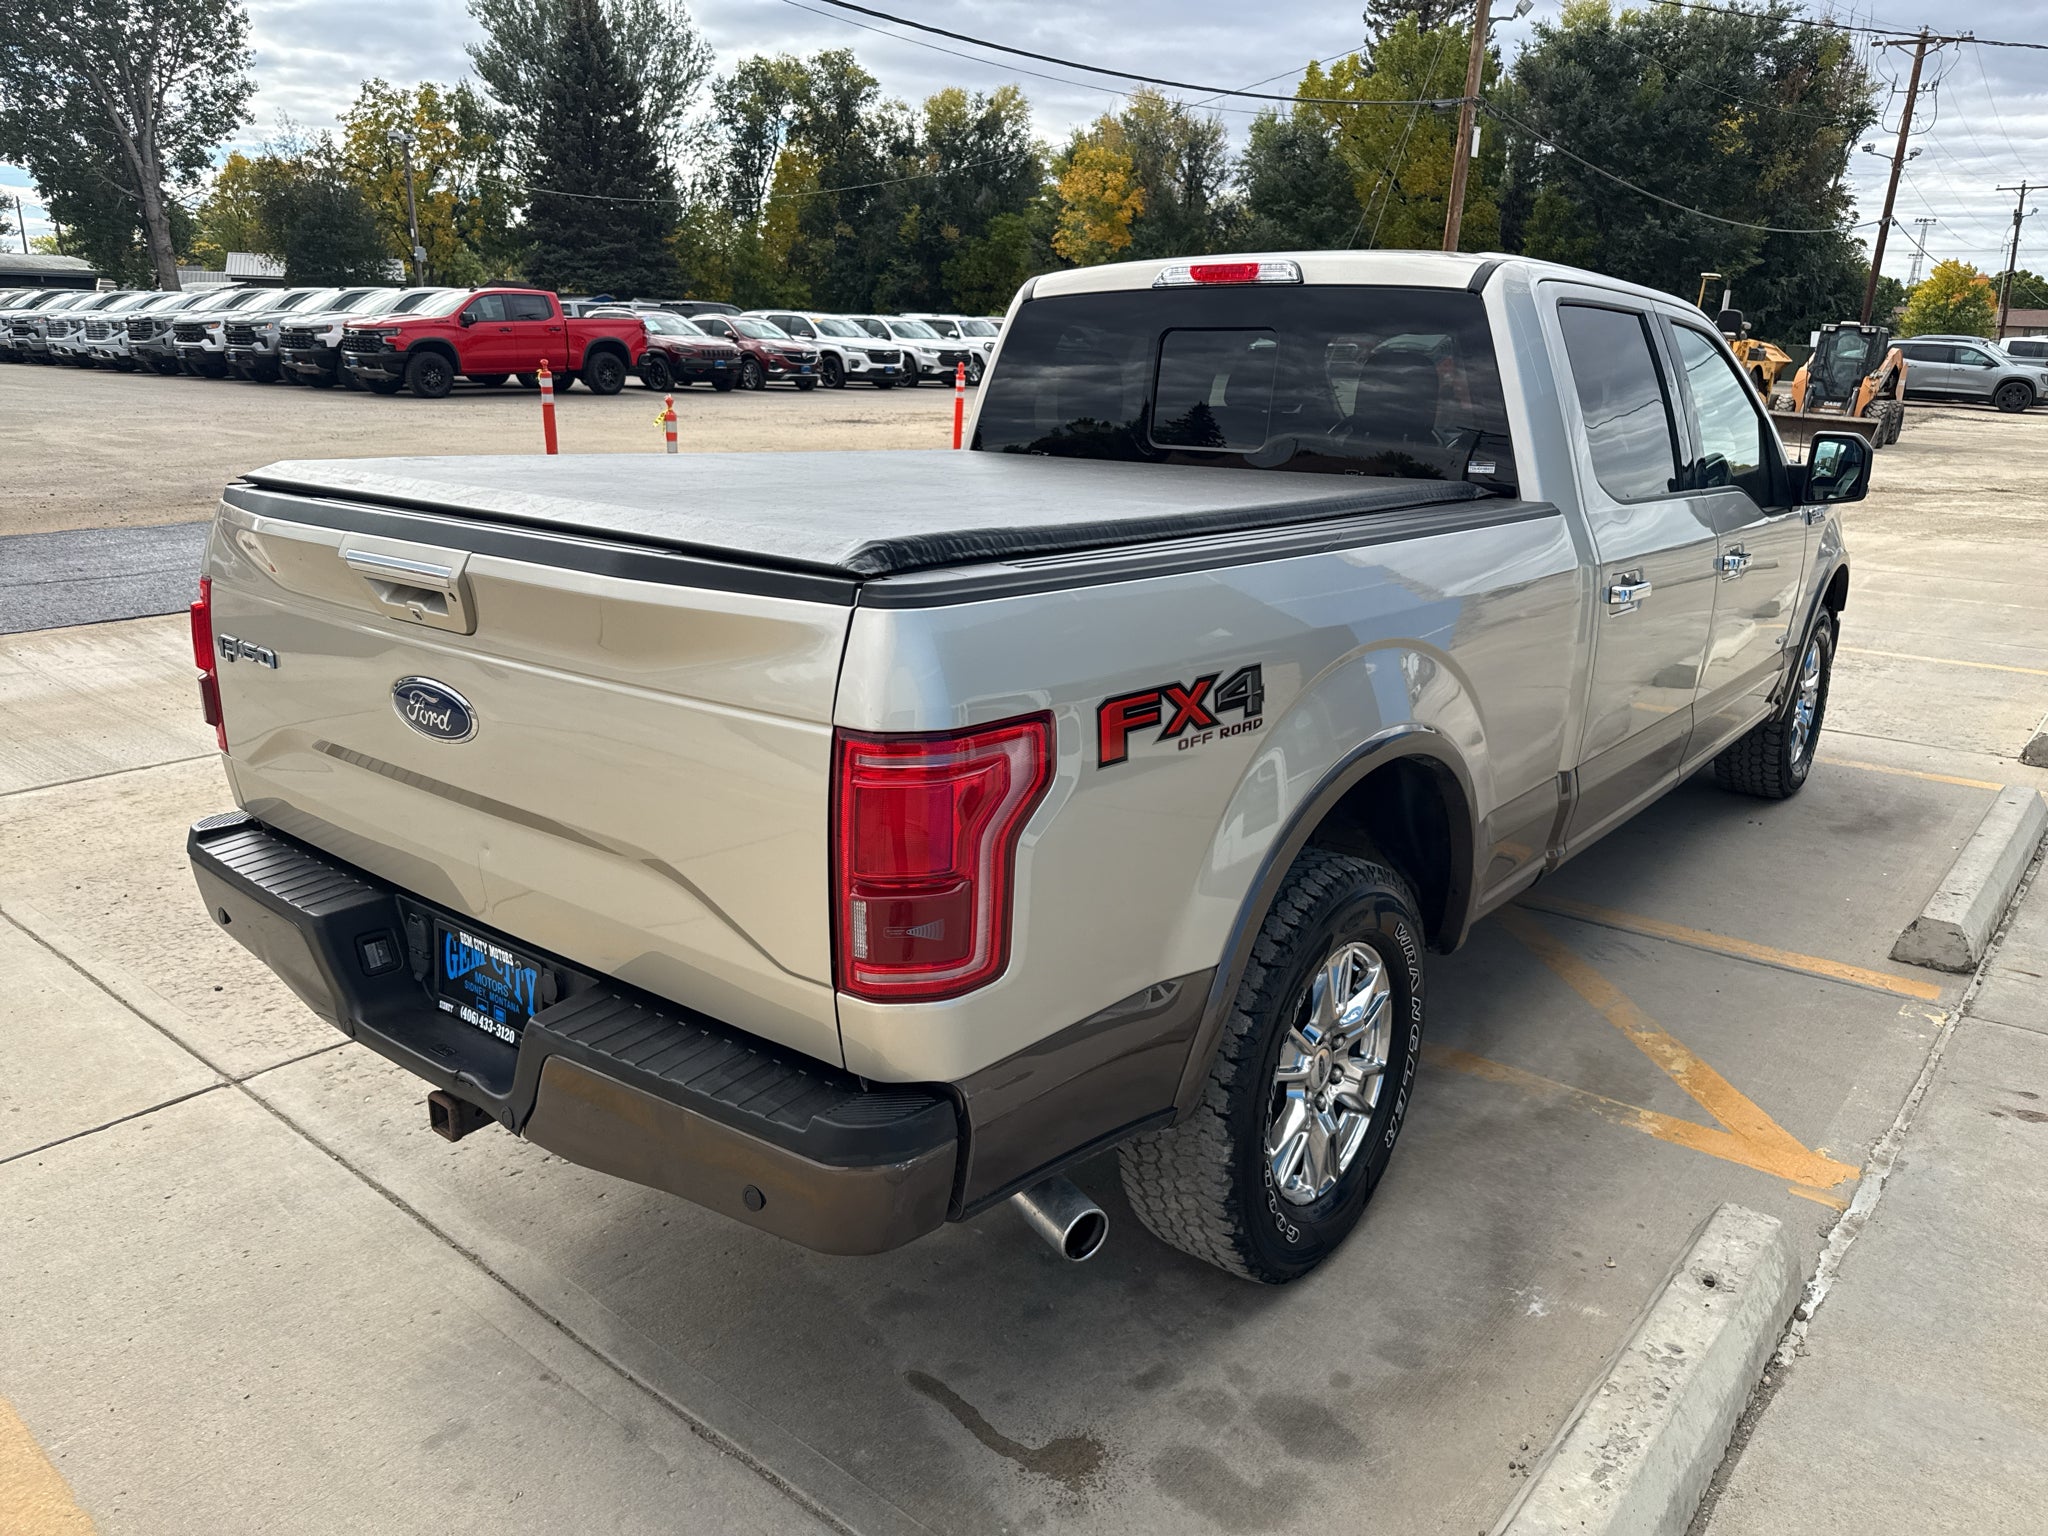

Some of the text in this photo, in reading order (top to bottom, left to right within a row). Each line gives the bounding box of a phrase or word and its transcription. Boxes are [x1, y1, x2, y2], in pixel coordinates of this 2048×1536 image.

[406, 690, 452, 731] Ford
[1096, 662, 1265, 770] FX4
[1178, 718, 1264, 751] OFF ROAD
[445, 931, 487, 980] GEM
[459, 931, 514, 967] GEM CITY MOTORS
[474, 971, 509, 998] MOTORS
[489, 991, 520, 1014] MONTANA
[1385, 922, 1421, 1148] WRANGLER
